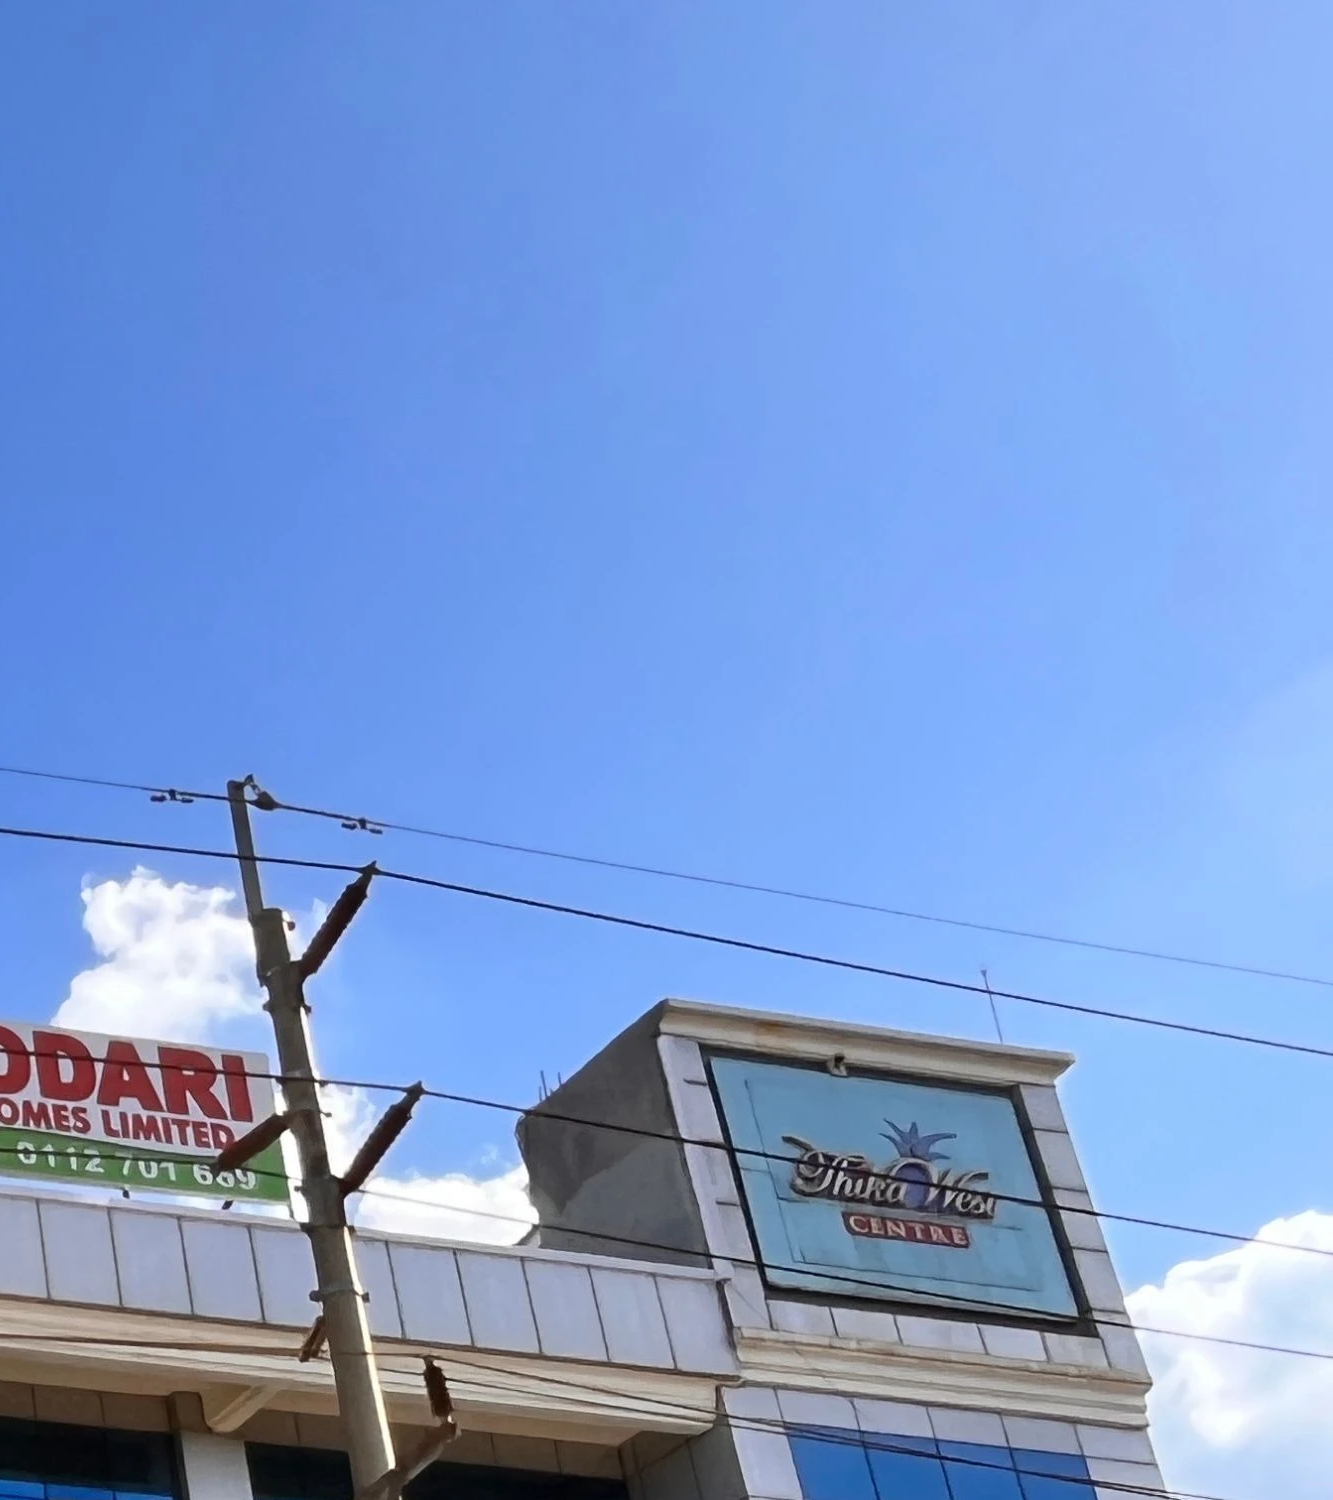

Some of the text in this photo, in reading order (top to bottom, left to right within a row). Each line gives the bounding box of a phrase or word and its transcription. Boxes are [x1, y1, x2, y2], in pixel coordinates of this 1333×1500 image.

[101, 1109, 235, 1150] LIMITED
[17, 1142, 104, 1173] 0112
[781, 1135, 996, 1215] Thika West
[848, 1215, 967, 1247] CENTRE
